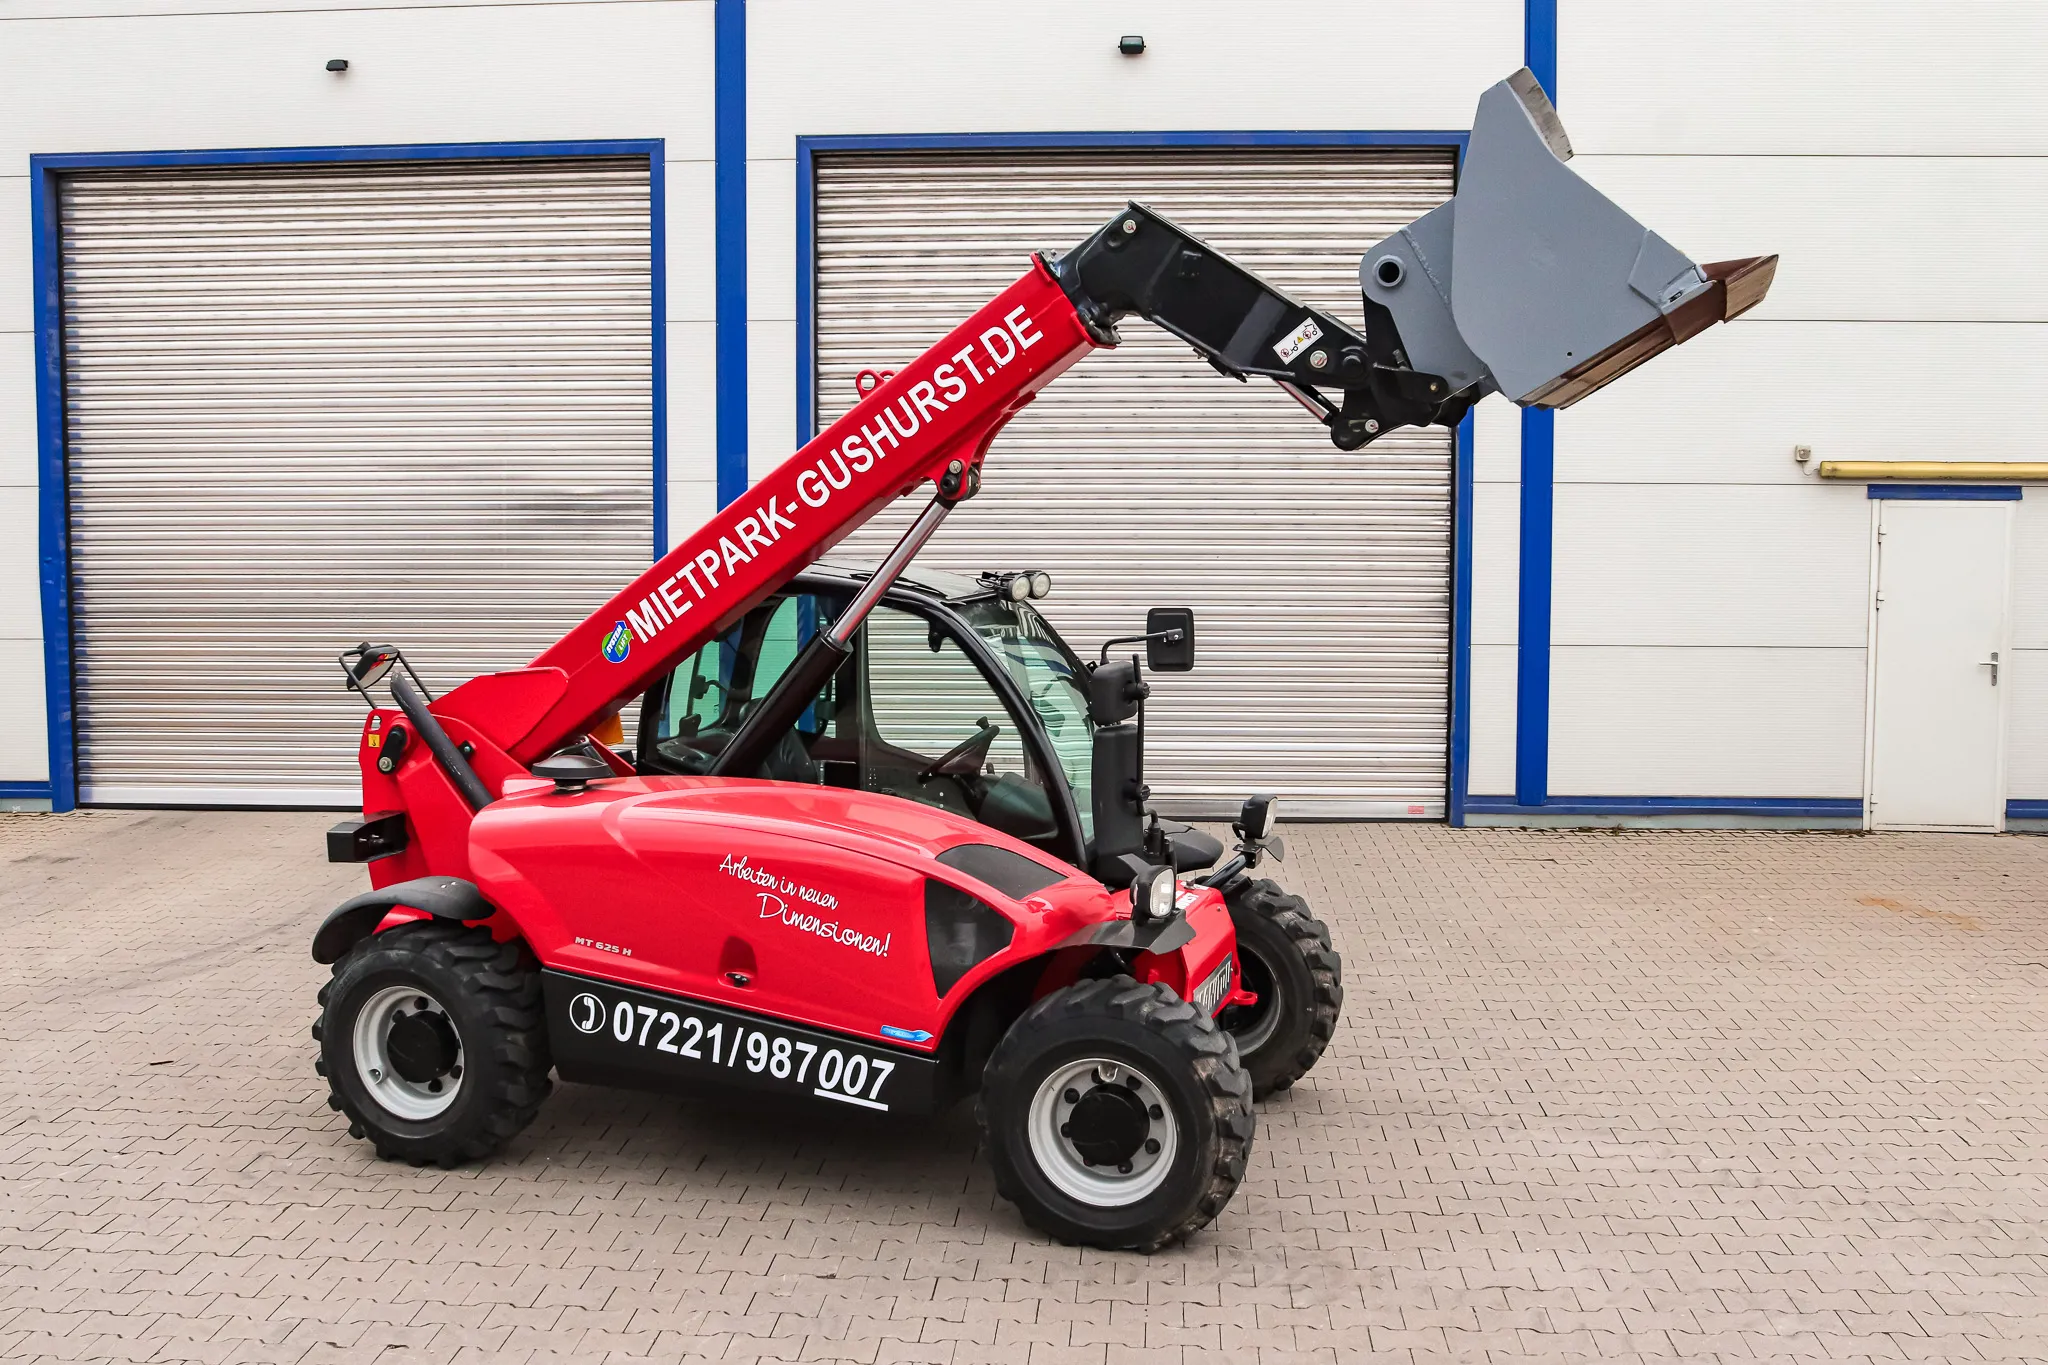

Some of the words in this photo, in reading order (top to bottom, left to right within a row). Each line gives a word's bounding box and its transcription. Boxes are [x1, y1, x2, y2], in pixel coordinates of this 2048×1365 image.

[625, 304, 1044, 644] MIETPARK-GUSHURST.DE
[606, 624, 623, 654] SYSTEM
[618, 633, 629, 651] LIFT
[719, 853, 779, 890] Arbeiten
[780, 876, 797, 897] in
[798, 885, 839, 911] neuen
[574, 936, 594, 947] MT
[595, 941, 620, 954] 625
[622, 947, 633, 957] H
[756, 892, 892, 957] Dimensionen!
[613, 1001, 895, 1101] 07221/987007
